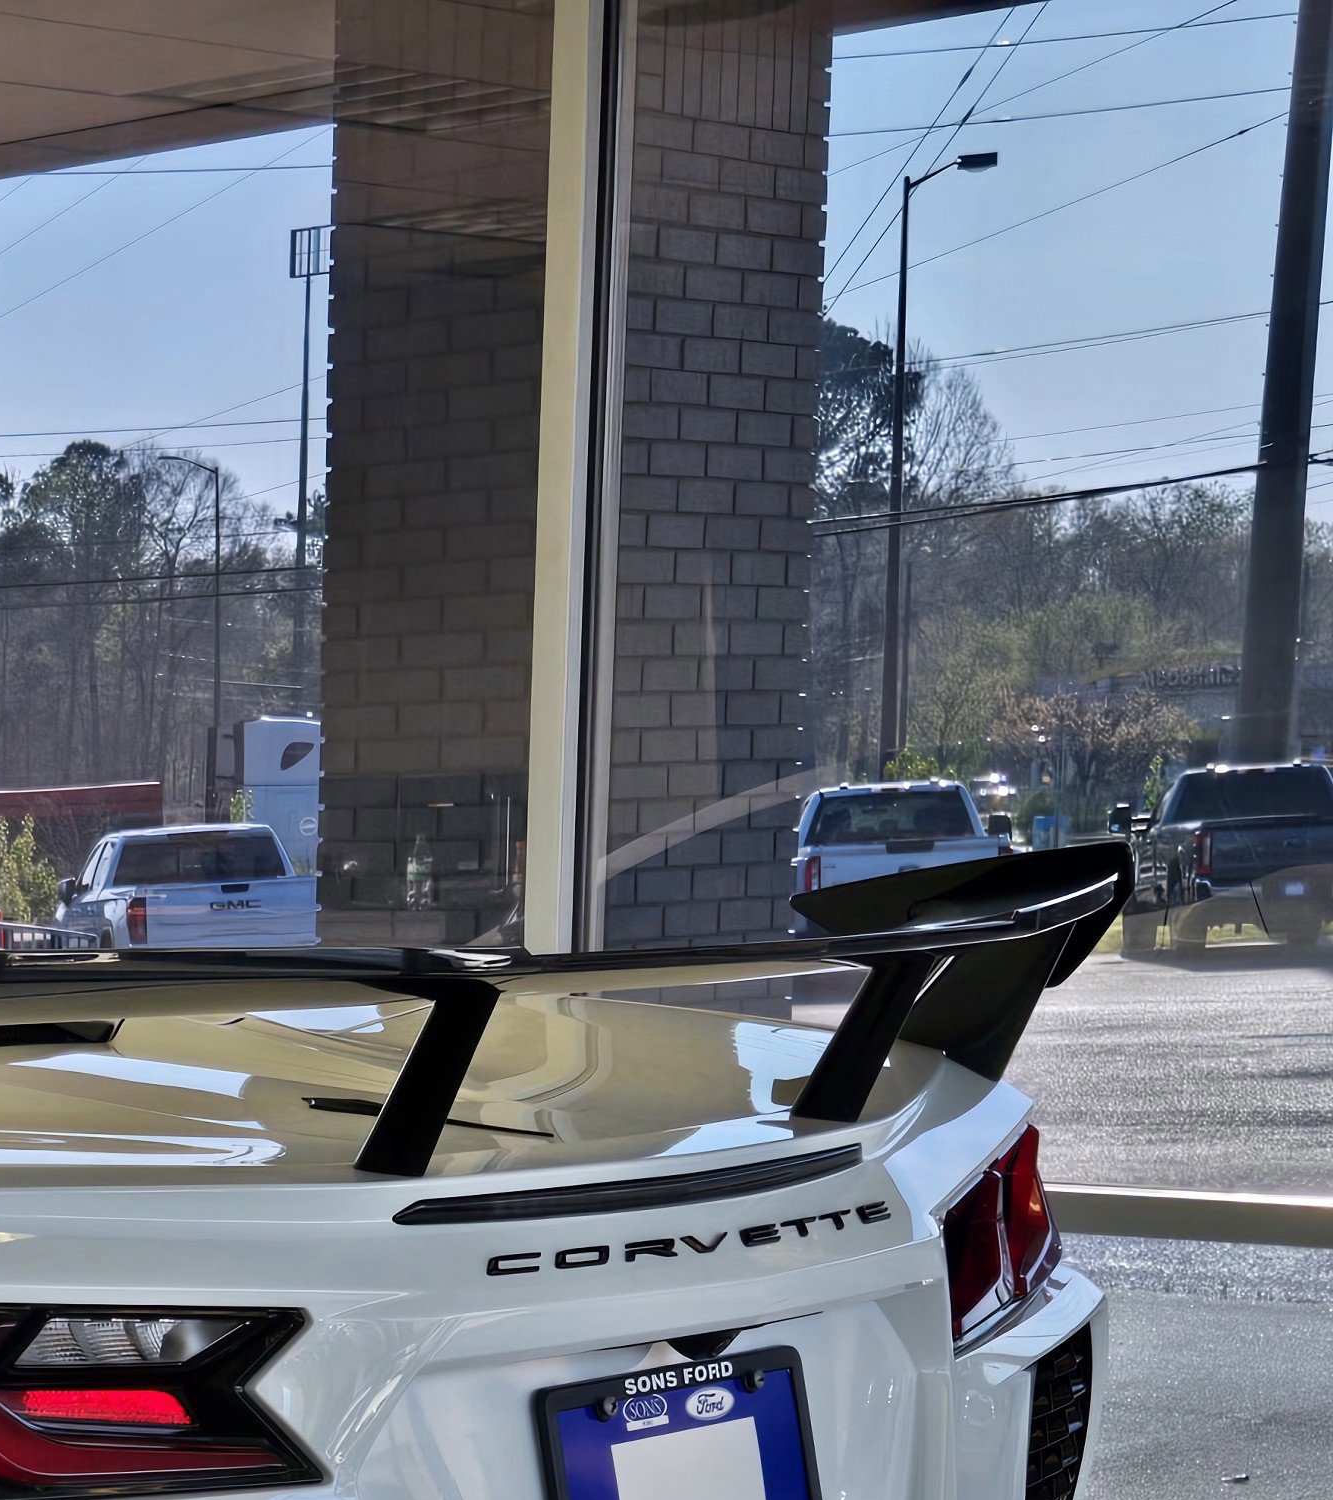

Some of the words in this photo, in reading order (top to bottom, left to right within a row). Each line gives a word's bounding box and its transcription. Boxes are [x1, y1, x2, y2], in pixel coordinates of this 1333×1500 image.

[209, 899, 262, 911] GMC
[486, 1200, 893, 1277] CORVETTE
[624, 1371, 678, 1395] SONS
[683, 1361, 733, 1384] FORD
[696, 1393, 725, 1415] Ford
